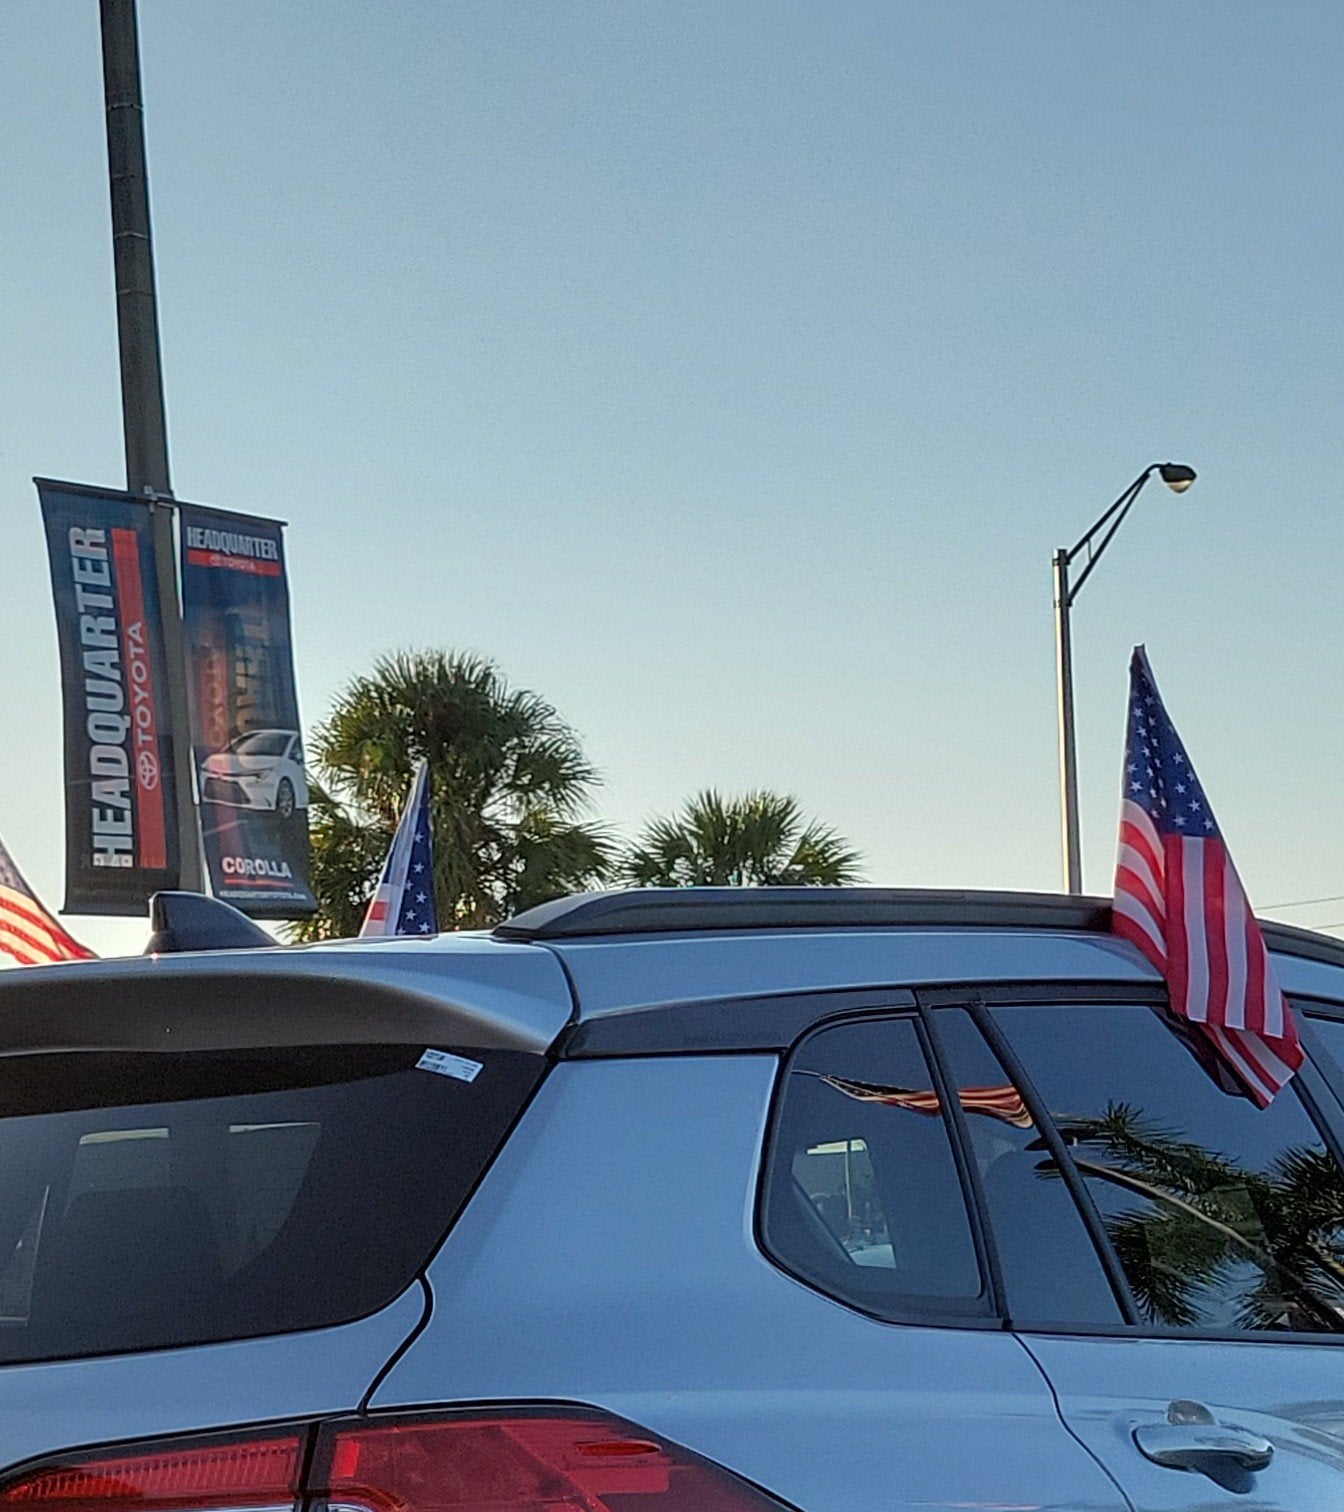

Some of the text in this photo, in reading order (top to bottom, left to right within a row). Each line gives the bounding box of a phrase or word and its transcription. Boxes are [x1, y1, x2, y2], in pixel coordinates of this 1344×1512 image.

[187, 526, 278, 560] HEADQUARTER
[69, 526, 133, 868] HEADQUARTER
[124, 621, 155, 746] TOYOTA
[221, 857, 292, 878] COROLLA
